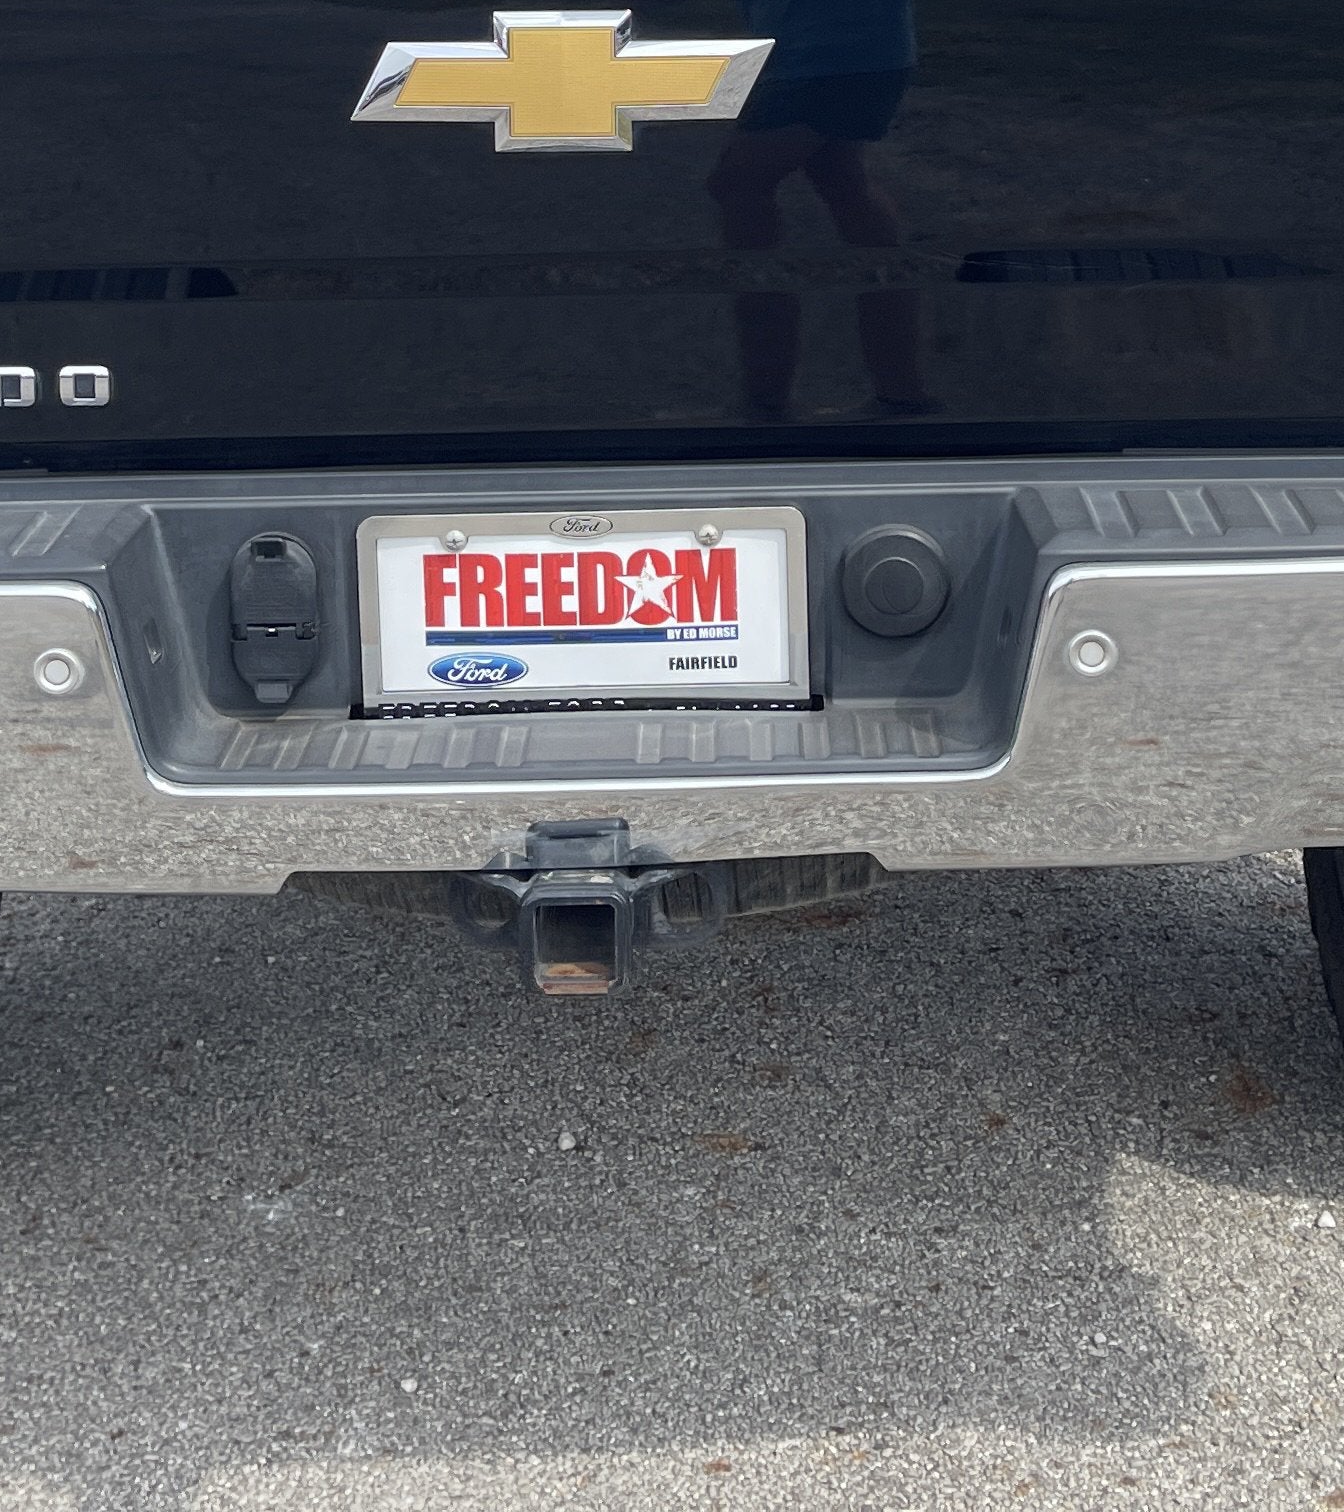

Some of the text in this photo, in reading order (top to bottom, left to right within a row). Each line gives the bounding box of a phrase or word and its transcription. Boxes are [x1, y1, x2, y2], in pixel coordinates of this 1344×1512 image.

[562, 517, 601, 533] Ford
[423, 548, 738, 627] FREEDOM
[666, 626, 737, 640] BY ED MORSE
[447, 656, 508, 682] Ford
[668, 654, 738, 671] FAIRFIELD
